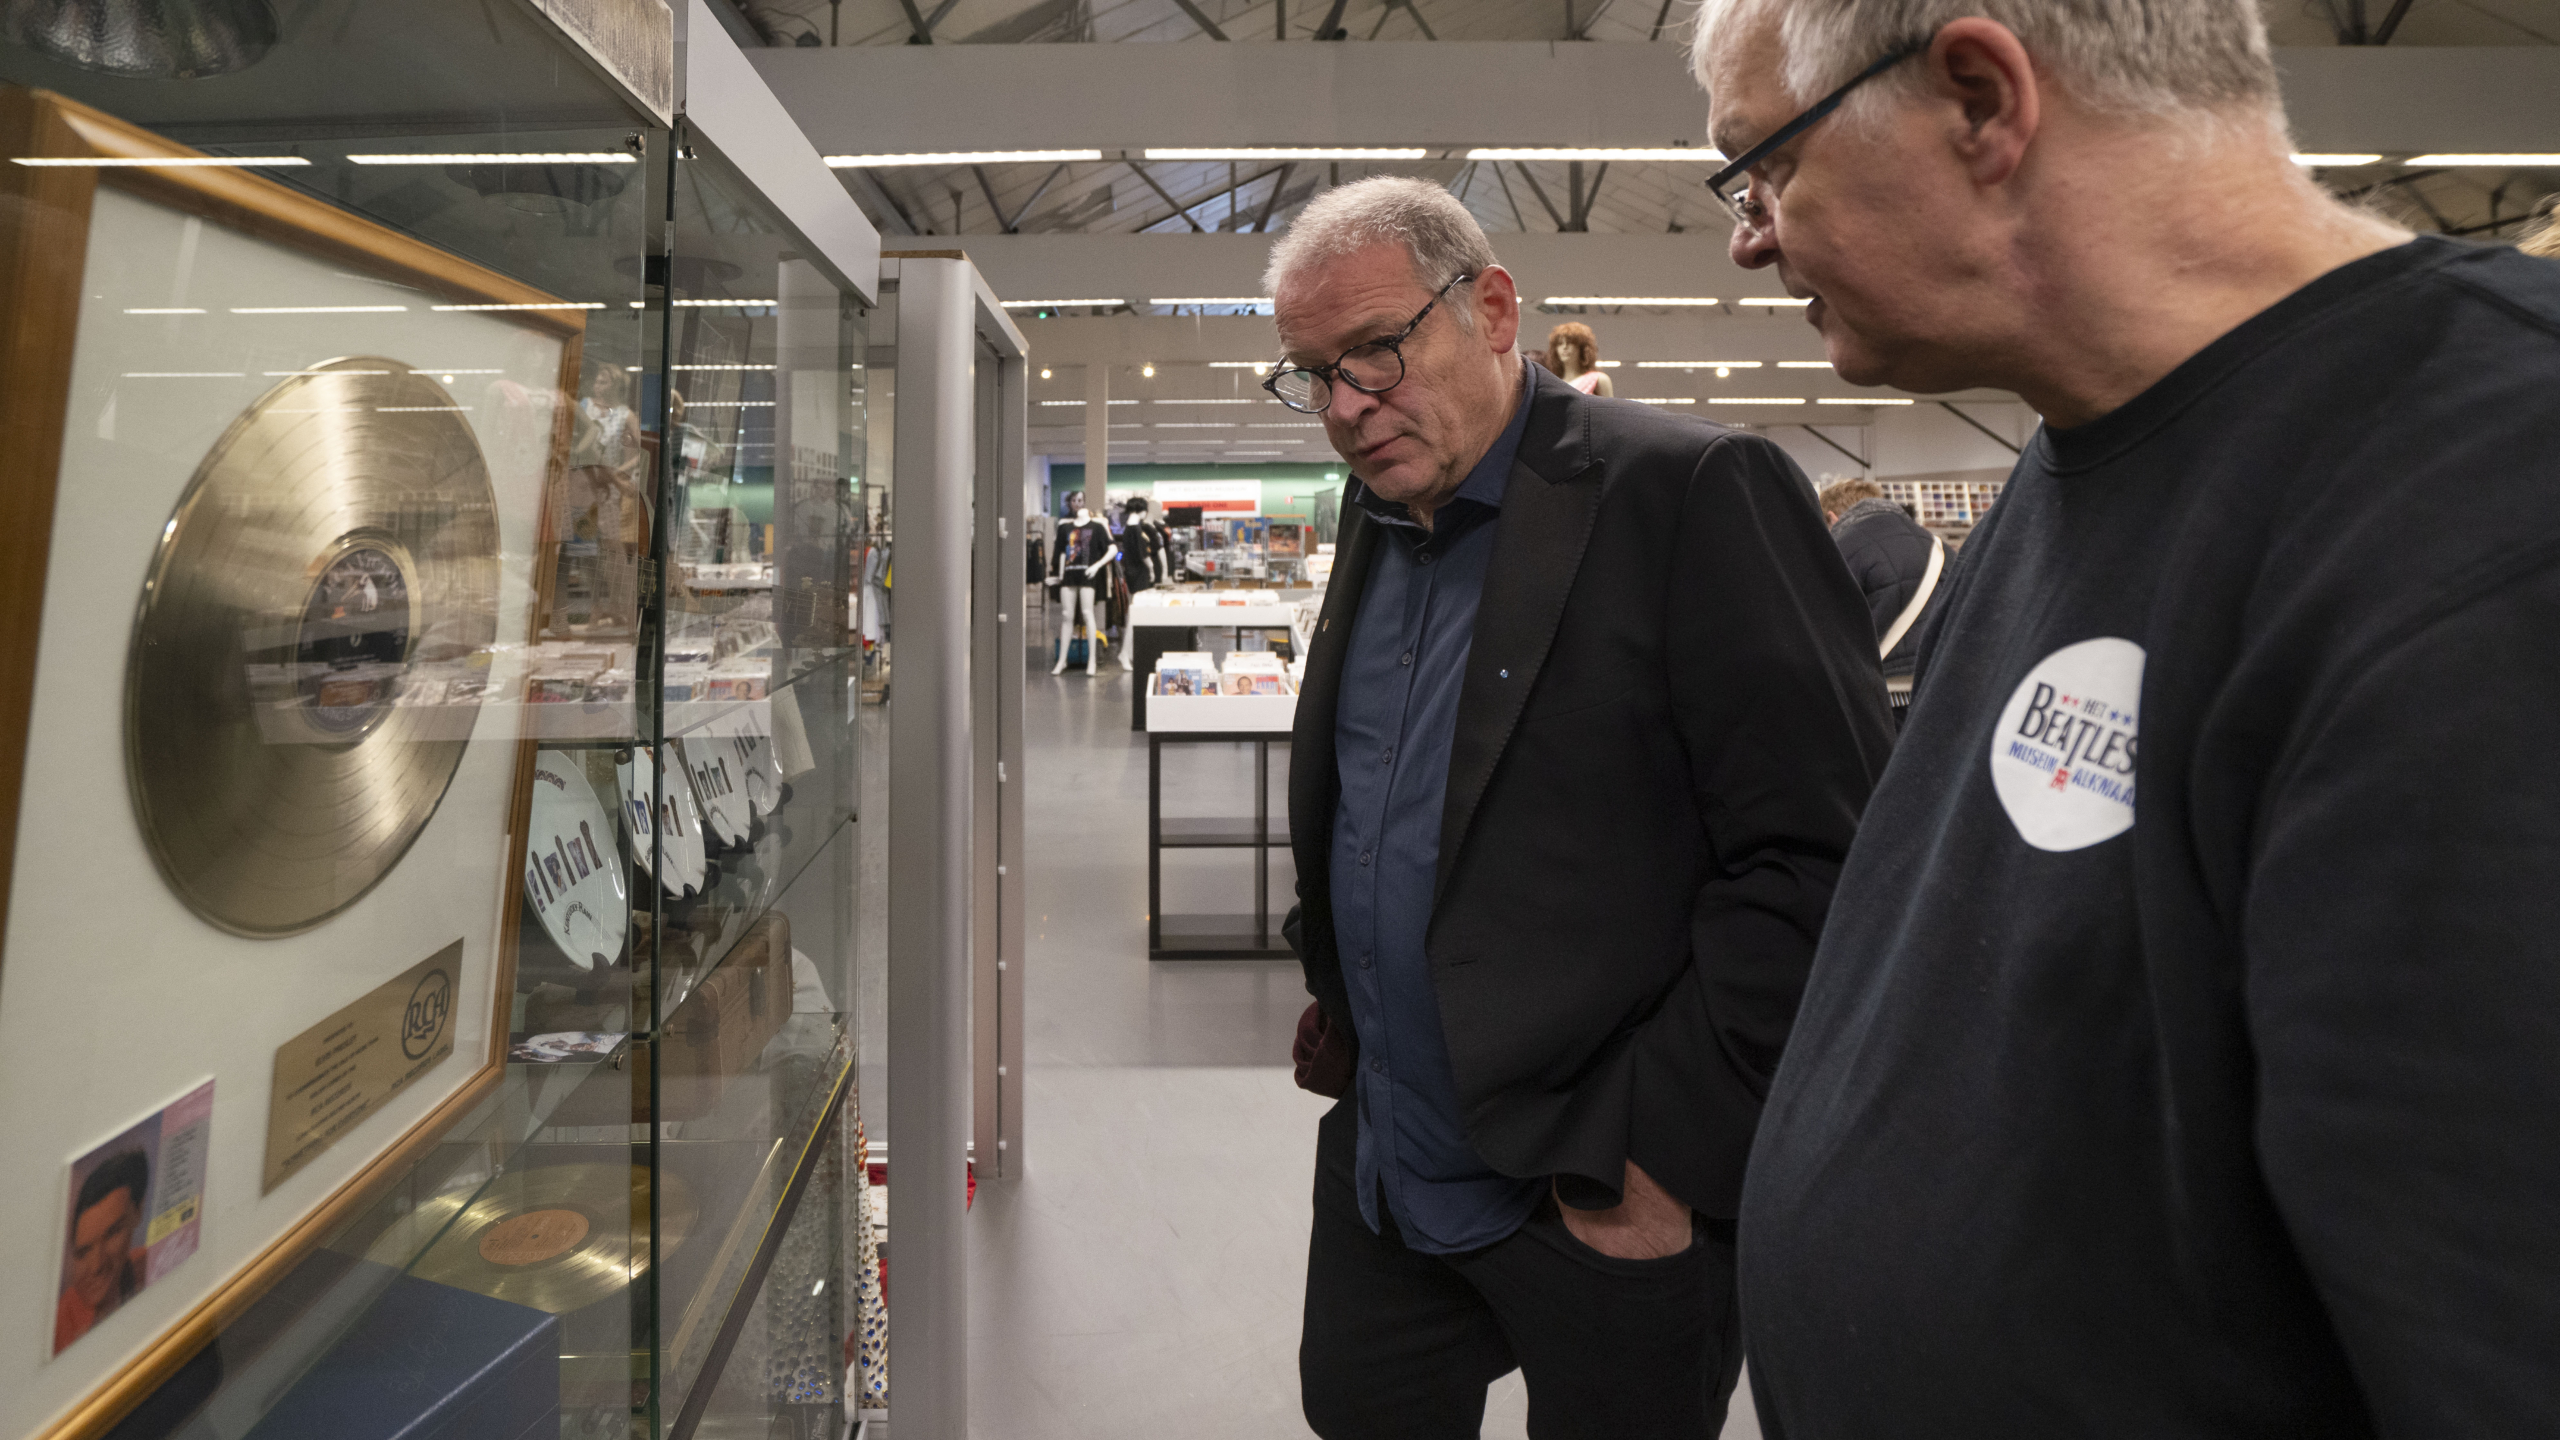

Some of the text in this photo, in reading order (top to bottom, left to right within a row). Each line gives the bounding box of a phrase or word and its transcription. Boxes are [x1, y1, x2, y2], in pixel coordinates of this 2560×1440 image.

[2018, 681, 2137, 775] BEATLES
[2083, 699, 2108, 719] HET
[2008, 741, 2136, 808] MUSEUM ALKMAA
[404, 984, 450, 1040] RCA
